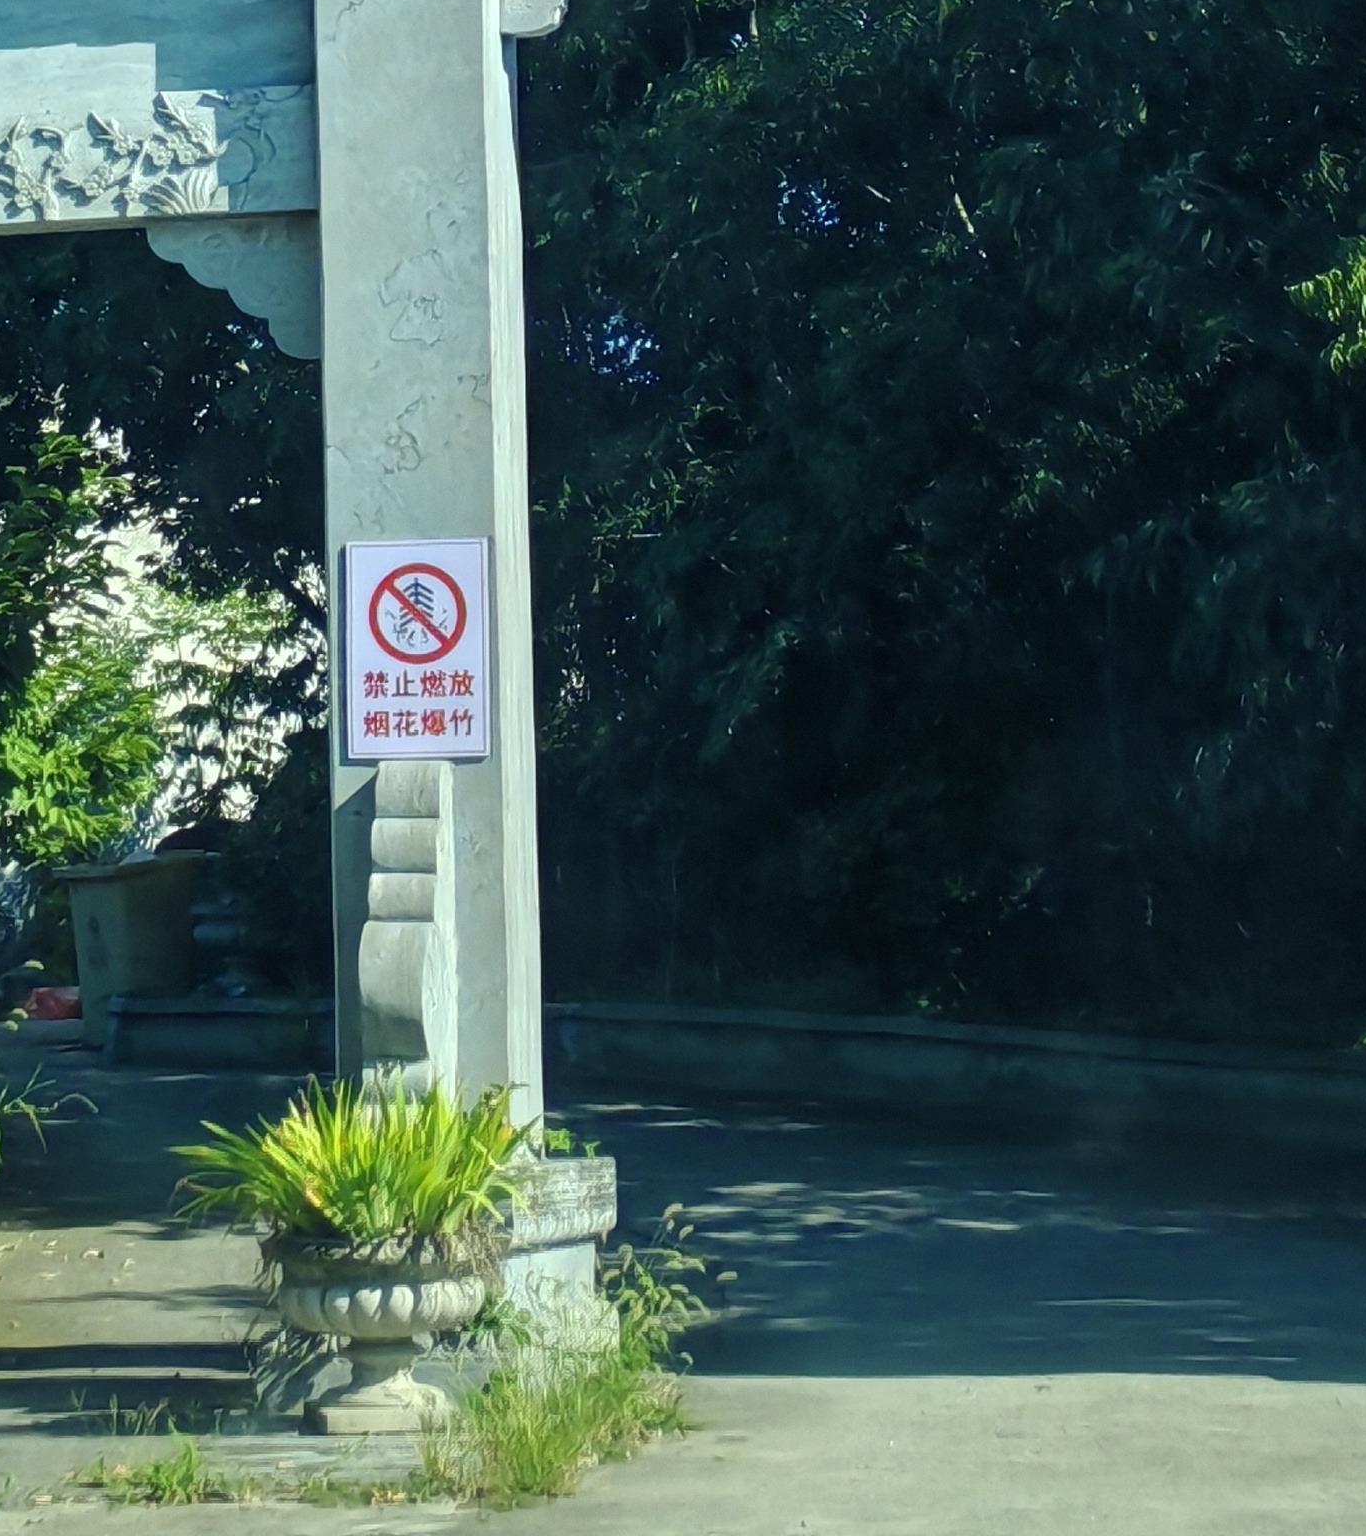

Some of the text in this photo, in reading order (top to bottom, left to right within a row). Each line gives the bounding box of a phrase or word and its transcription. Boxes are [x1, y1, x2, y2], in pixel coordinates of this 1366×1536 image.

[363, 670, 474, 699] 禁止燃放
[364, 709, 473, 737] 烟花爆竹
